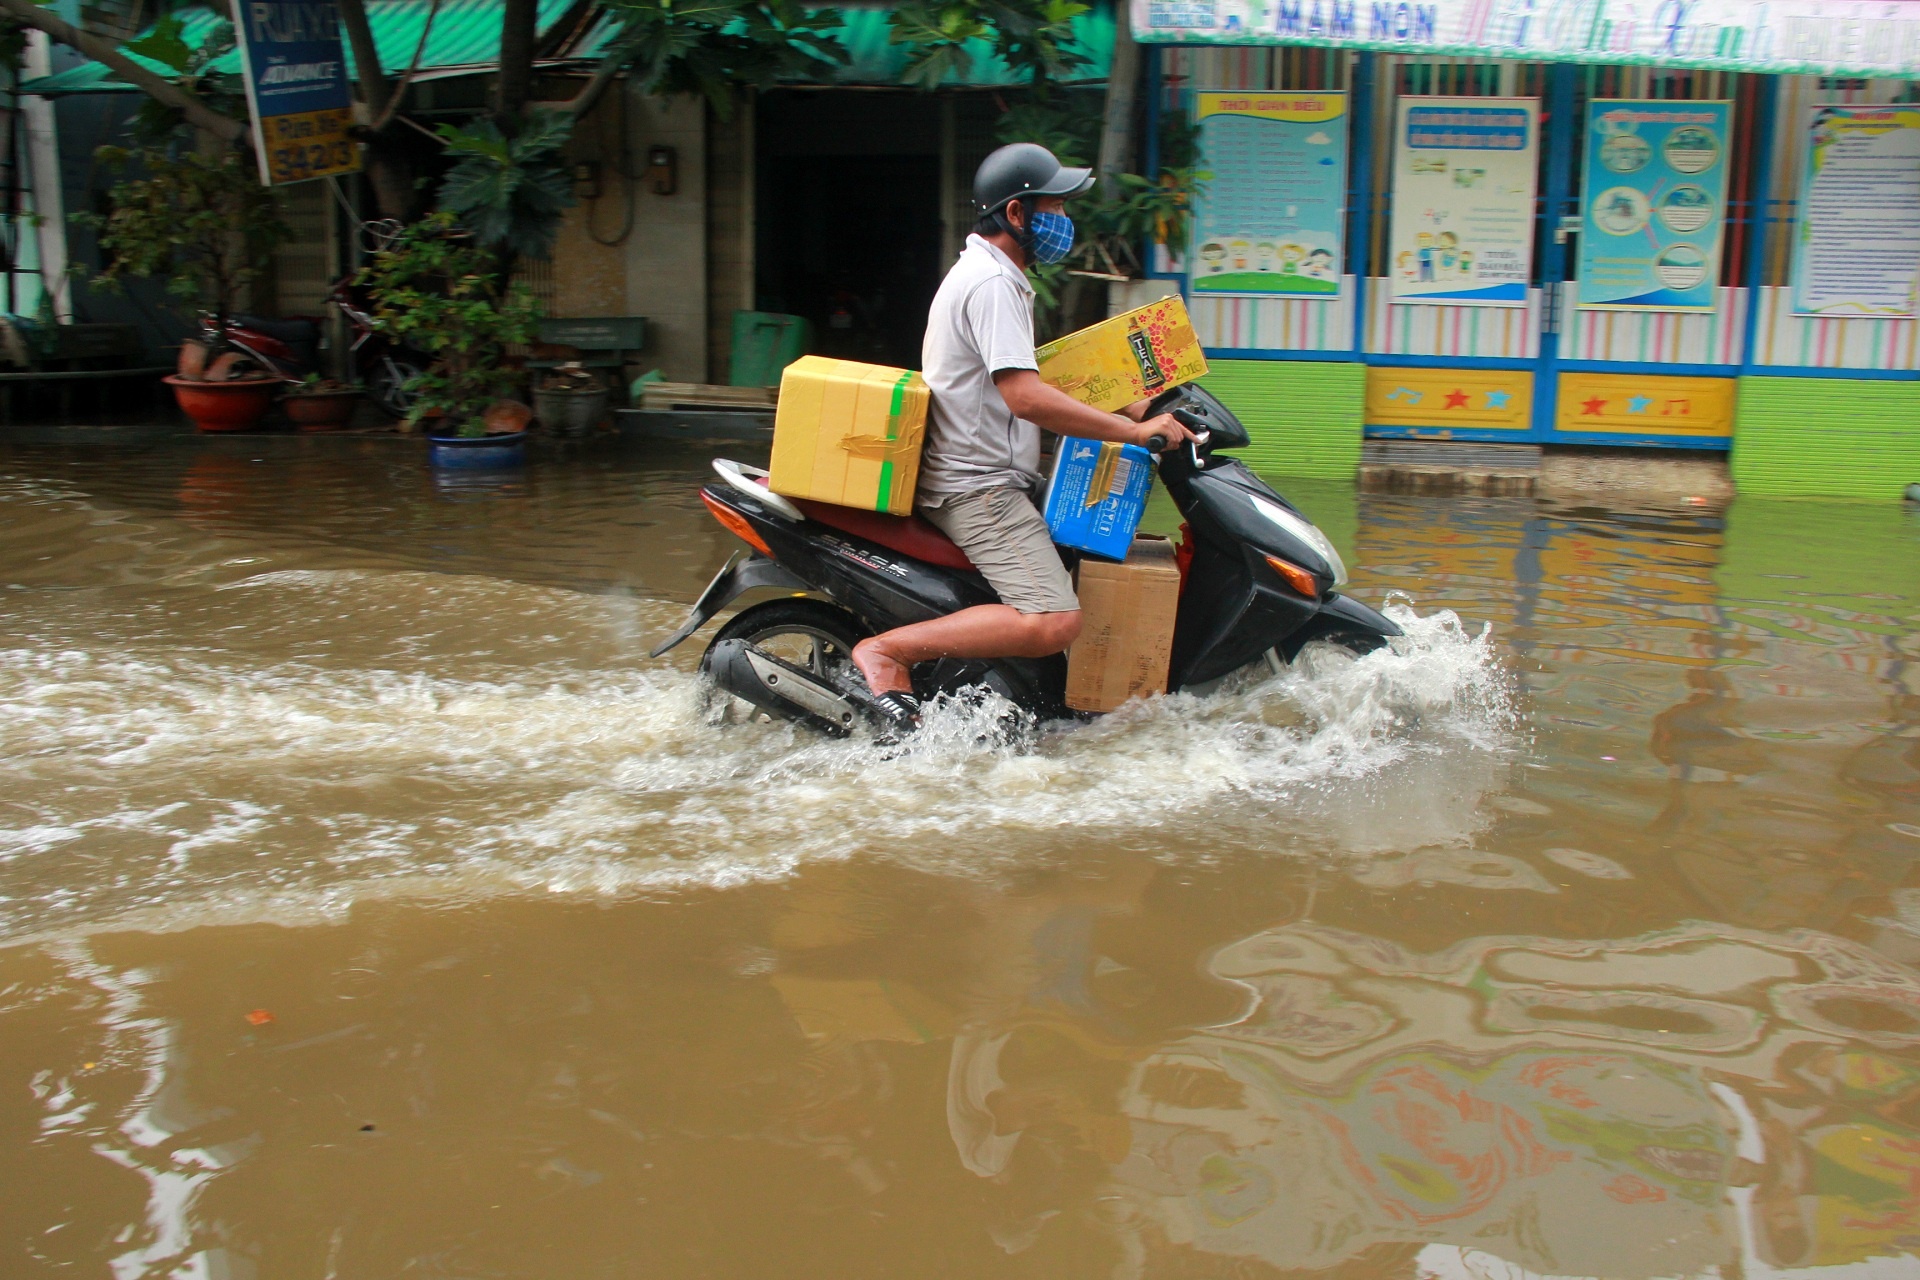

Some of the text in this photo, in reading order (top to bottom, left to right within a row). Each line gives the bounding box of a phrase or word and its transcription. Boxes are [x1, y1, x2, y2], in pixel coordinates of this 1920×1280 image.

[1370, 2, 1437, 43] NON
[259, 61, 340, 85] ADVANCE
[1174, 360, 1203, 381] 2016
[1085, 377, 1121, 398] Xuân
